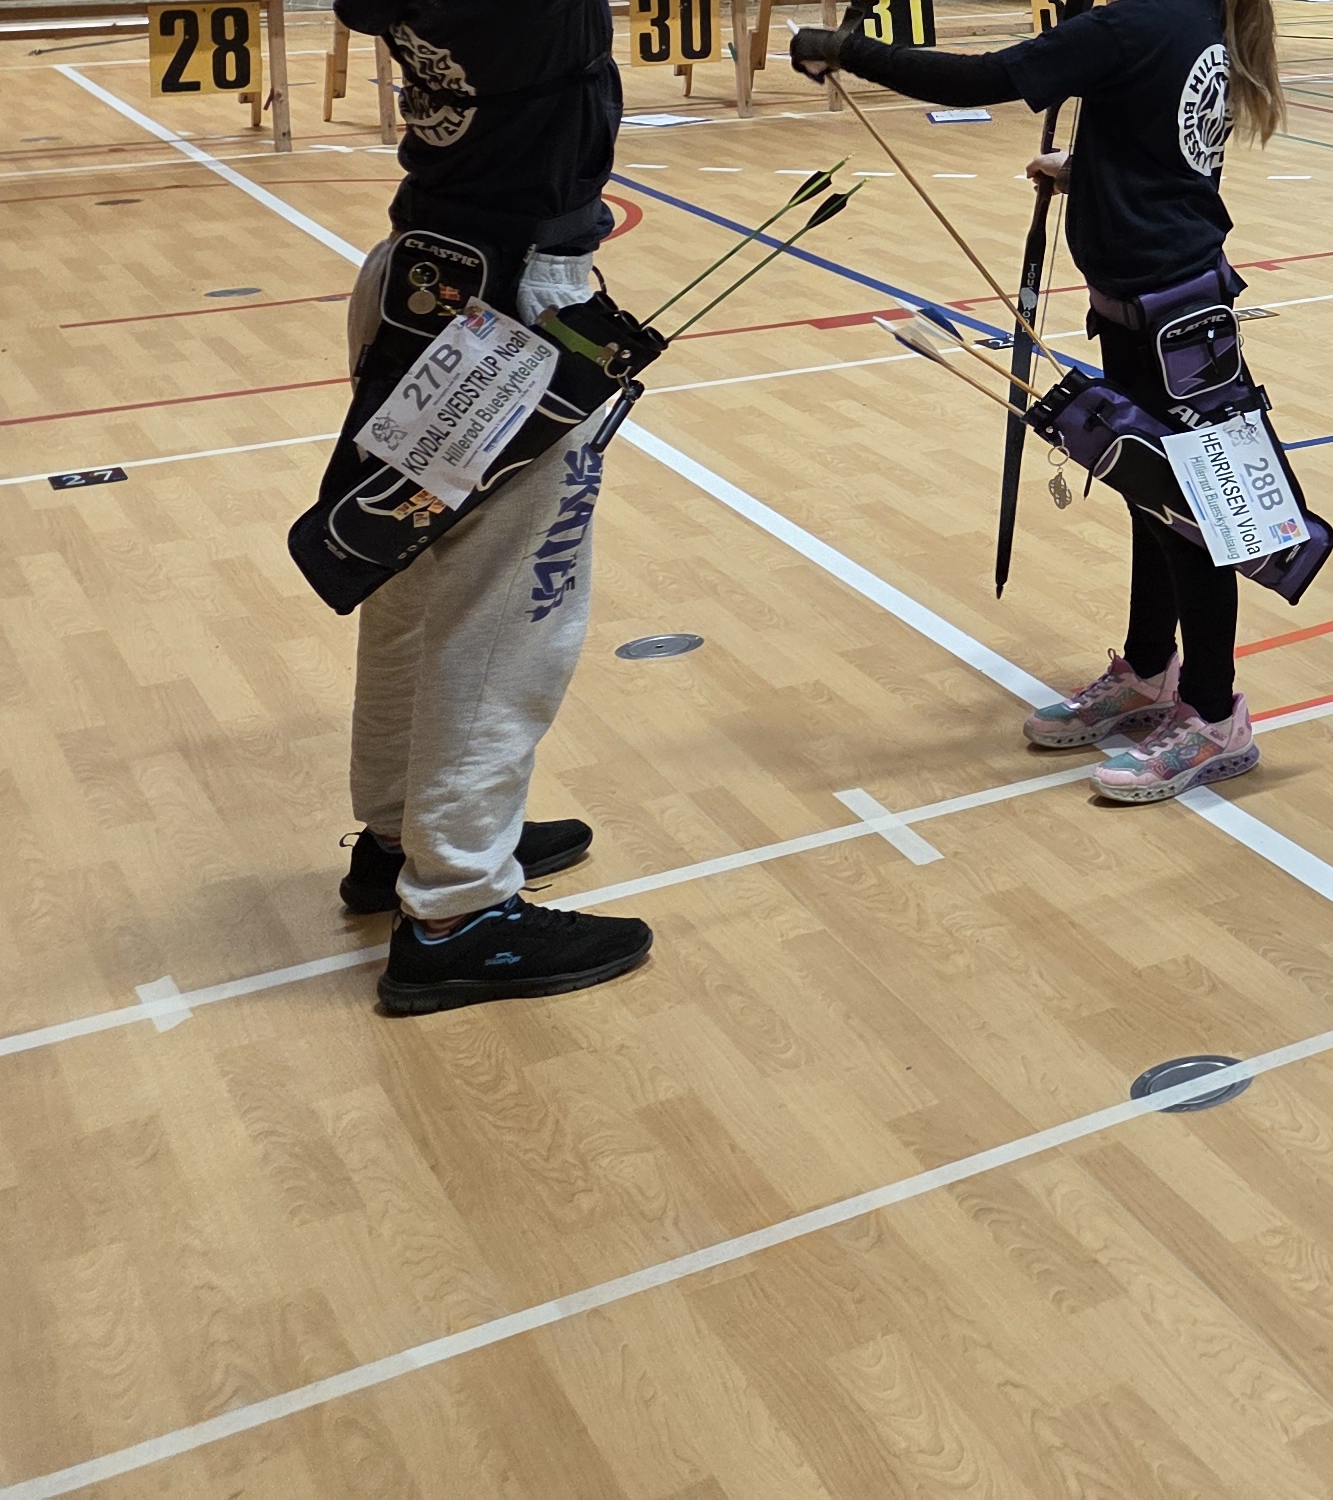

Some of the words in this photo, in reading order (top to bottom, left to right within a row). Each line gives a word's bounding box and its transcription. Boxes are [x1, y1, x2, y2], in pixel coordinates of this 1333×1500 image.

[158, 7, 251, 93] 28
[1189, 50, 1230, 94] HILLE
[404, 238, 481, 269] CLASSIC
[1166, 312, 1226, 339] CLASSIC
[400, 340, 464, 412] 27B
[401, 421, 450, 477] KOVDAL
[436, 353, 504, 430] SVEDSTRUP
[493, 327, 531, 362] Noah
[442, 418, 485, 468] Hillerød
[475, 343, 553, 424] Bueskyttelaug
[62, 470, 113, 486] 27
[1199, 431, 1250, 517] HENRIKSEN
[1236, 517, 1265, 555] Viola
[1243, 456, 1285, 512] 28B
